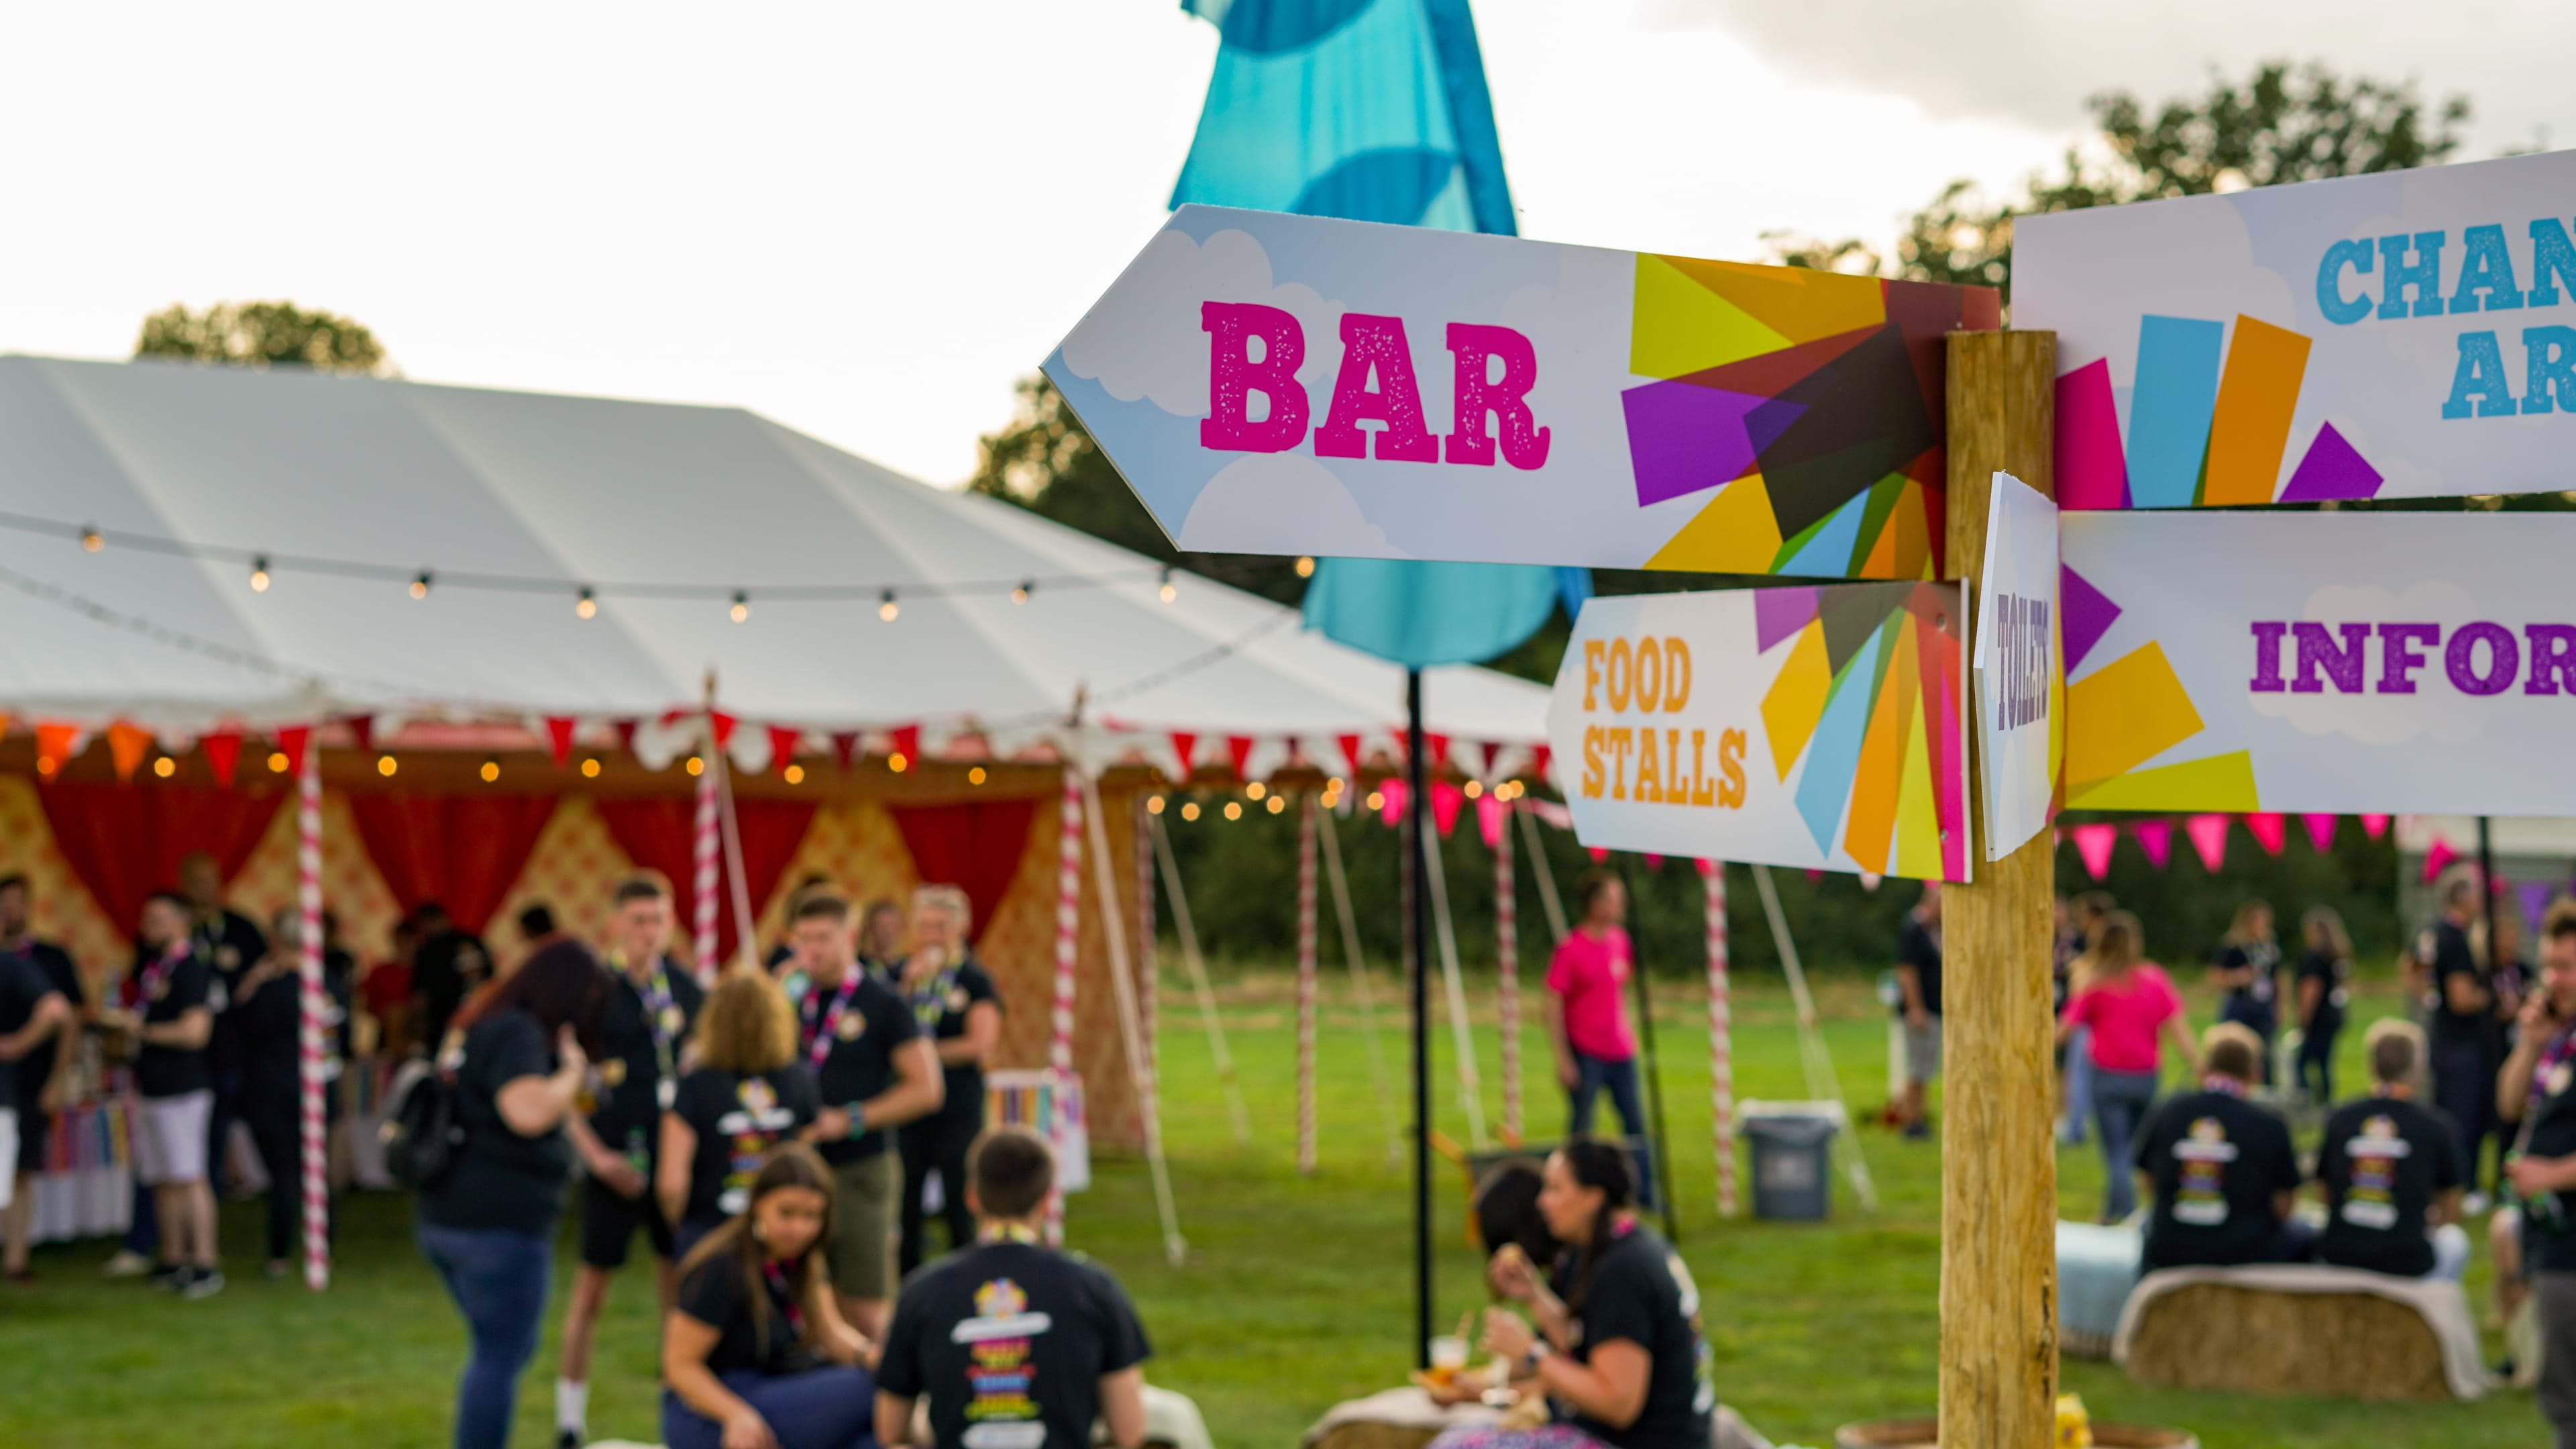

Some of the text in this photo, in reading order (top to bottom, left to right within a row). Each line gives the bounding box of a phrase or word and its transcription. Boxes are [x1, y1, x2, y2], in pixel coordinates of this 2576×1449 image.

[1201, 301, 1551, 470] BAR
[1583, 635, 1692, 714] FOOD
[1997, 593, 2049, 731] TOILETS
[2250, 621, 2576, 696] INFOR
[1582, 724, 1748, 810] STALLS
